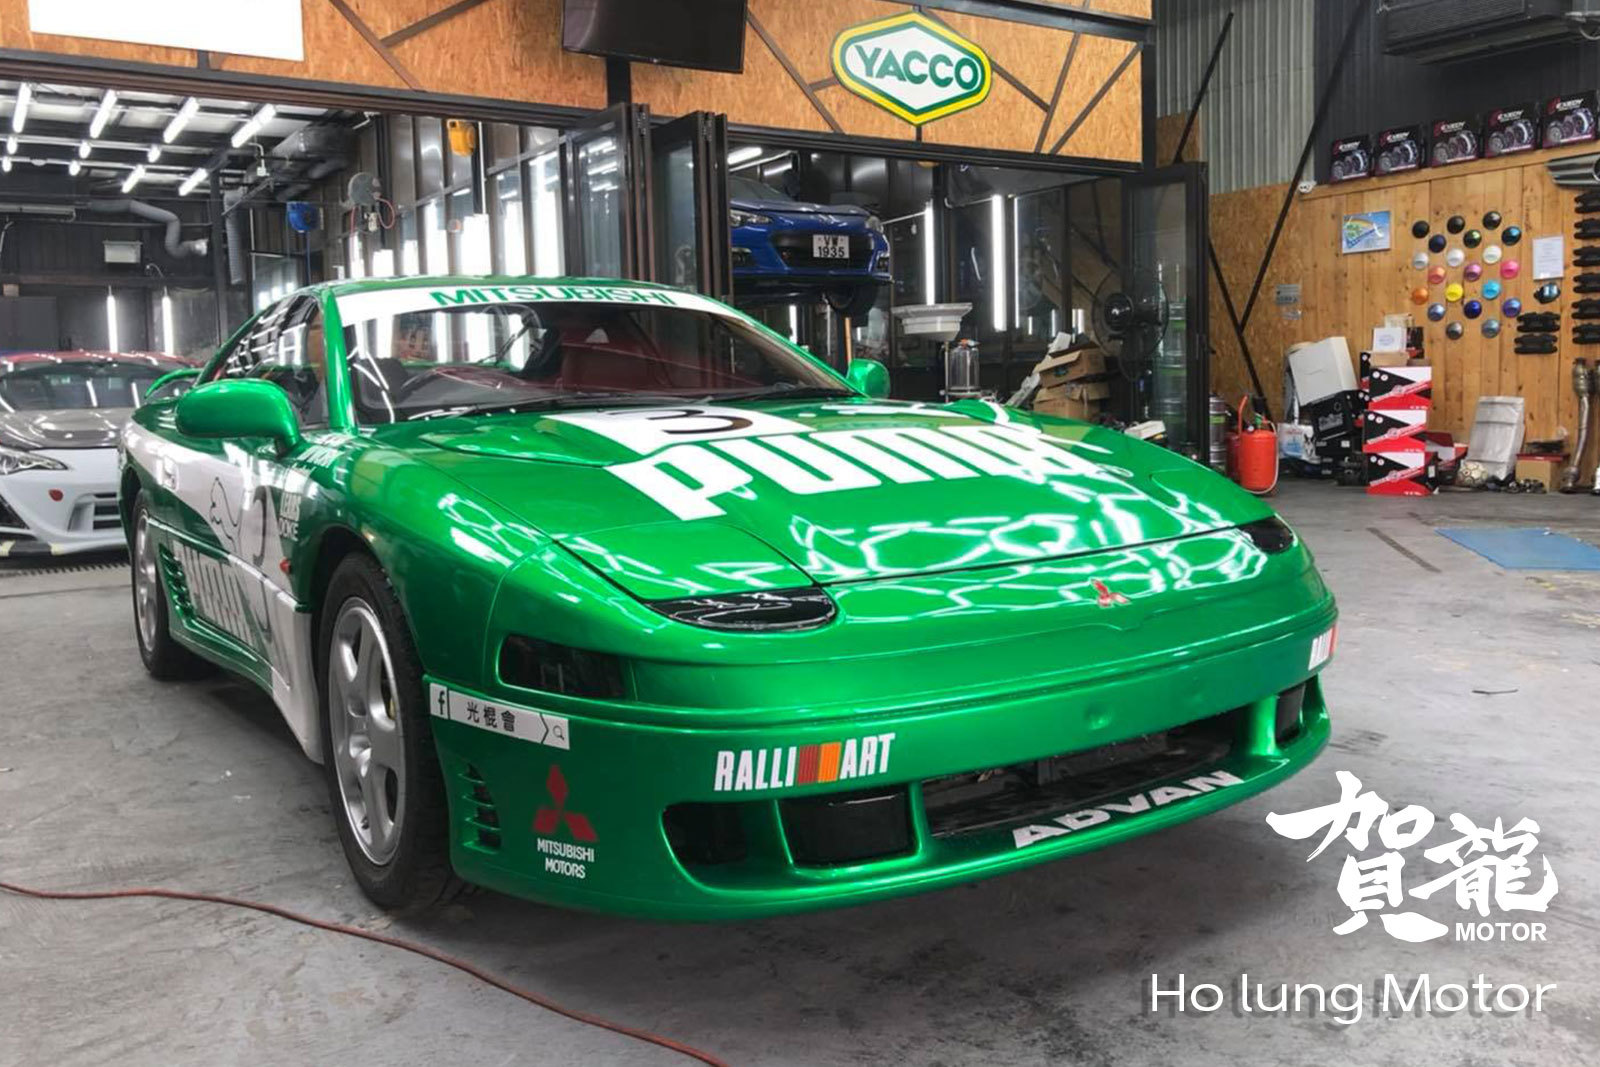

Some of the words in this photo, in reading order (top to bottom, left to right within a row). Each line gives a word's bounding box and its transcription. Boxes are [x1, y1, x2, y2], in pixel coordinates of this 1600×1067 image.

[854, 44, 979, 91] YACCO
[818, 246, 845, 258] 1935
[429, 285, 677, 307] MITSUBISHI
[602, 424, 1106, 521] PUMA
[466, 701, 515, 732] 光棍會
[714, 746, 797, 791] RALLI
[839, 733, 896, 780] ART
[1012, 770, 1245, 849] ADVAN
[537, 838, 595, 862] MITSUBISHI
[545, 857, 586, 879] MOTORS
